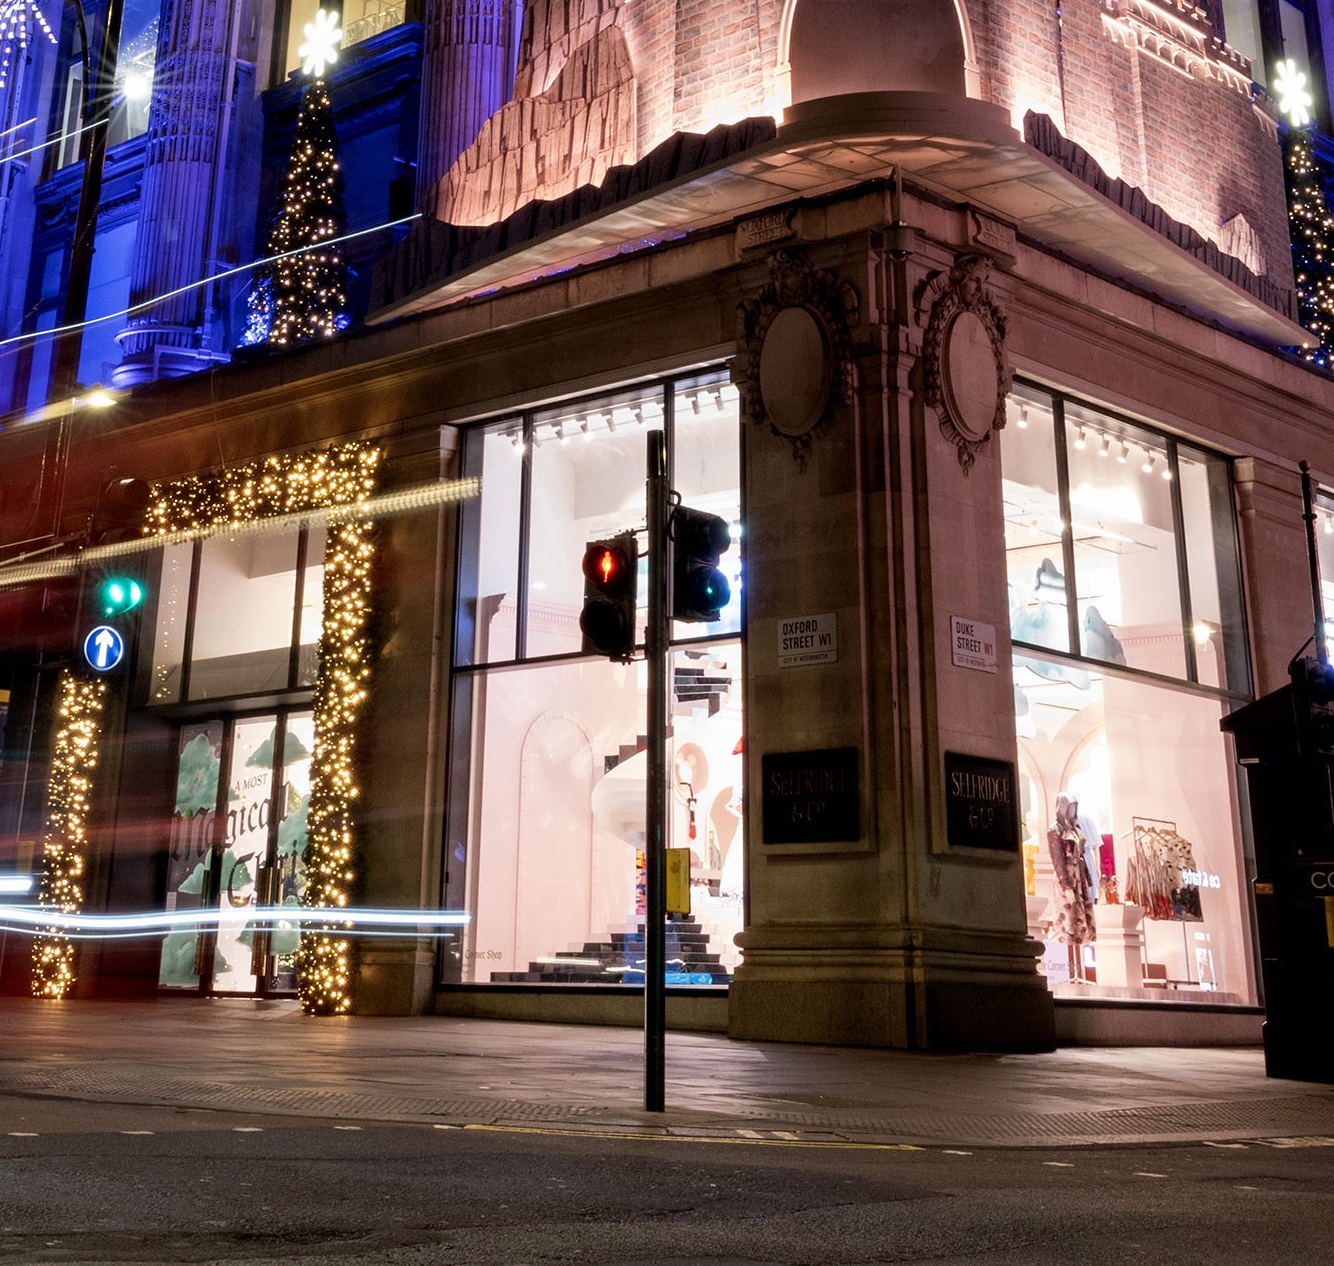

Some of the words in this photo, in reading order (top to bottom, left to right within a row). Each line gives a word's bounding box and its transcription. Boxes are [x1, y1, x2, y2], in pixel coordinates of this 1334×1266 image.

[747, 211, 786, 232] OXFORD
[747, 226, 783, 245] STREET
[783, 620, 818, 635] OXFORD
[956, 621, 974, 637] DUKE
[783, 635, 815, 650] STREET
[819, 633, 831, 646] W1
[957, 636, 981, 653] STREET
[984, 642, 993, 656] W1
[234, 781, 241, 792] A
[242, 773, 268, 791] MOST
[951, 770, 1011, 804] SELFRIDGE
